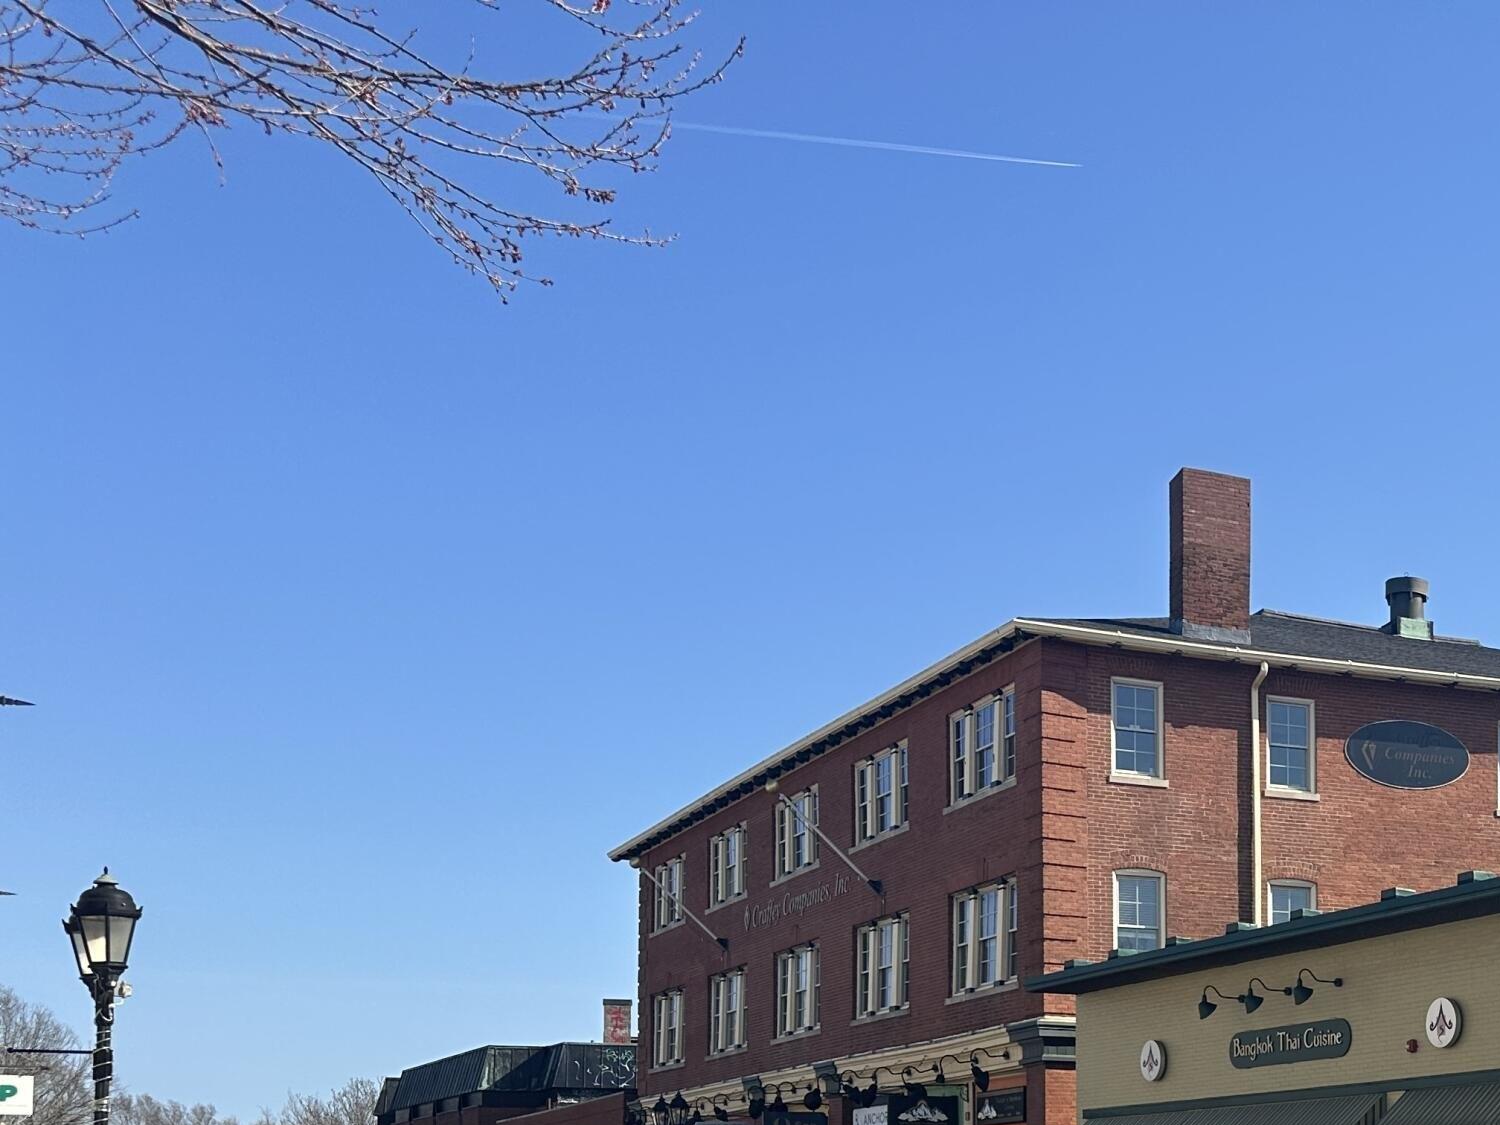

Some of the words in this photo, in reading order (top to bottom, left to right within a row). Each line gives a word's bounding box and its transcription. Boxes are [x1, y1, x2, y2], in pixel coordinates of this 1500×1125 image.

[1233, 1035, 1274, 1061] Bangkok
[1277, 1031, 1301, 1052] Thai
[1303, 1027, 1343, 1049] Cuisine
